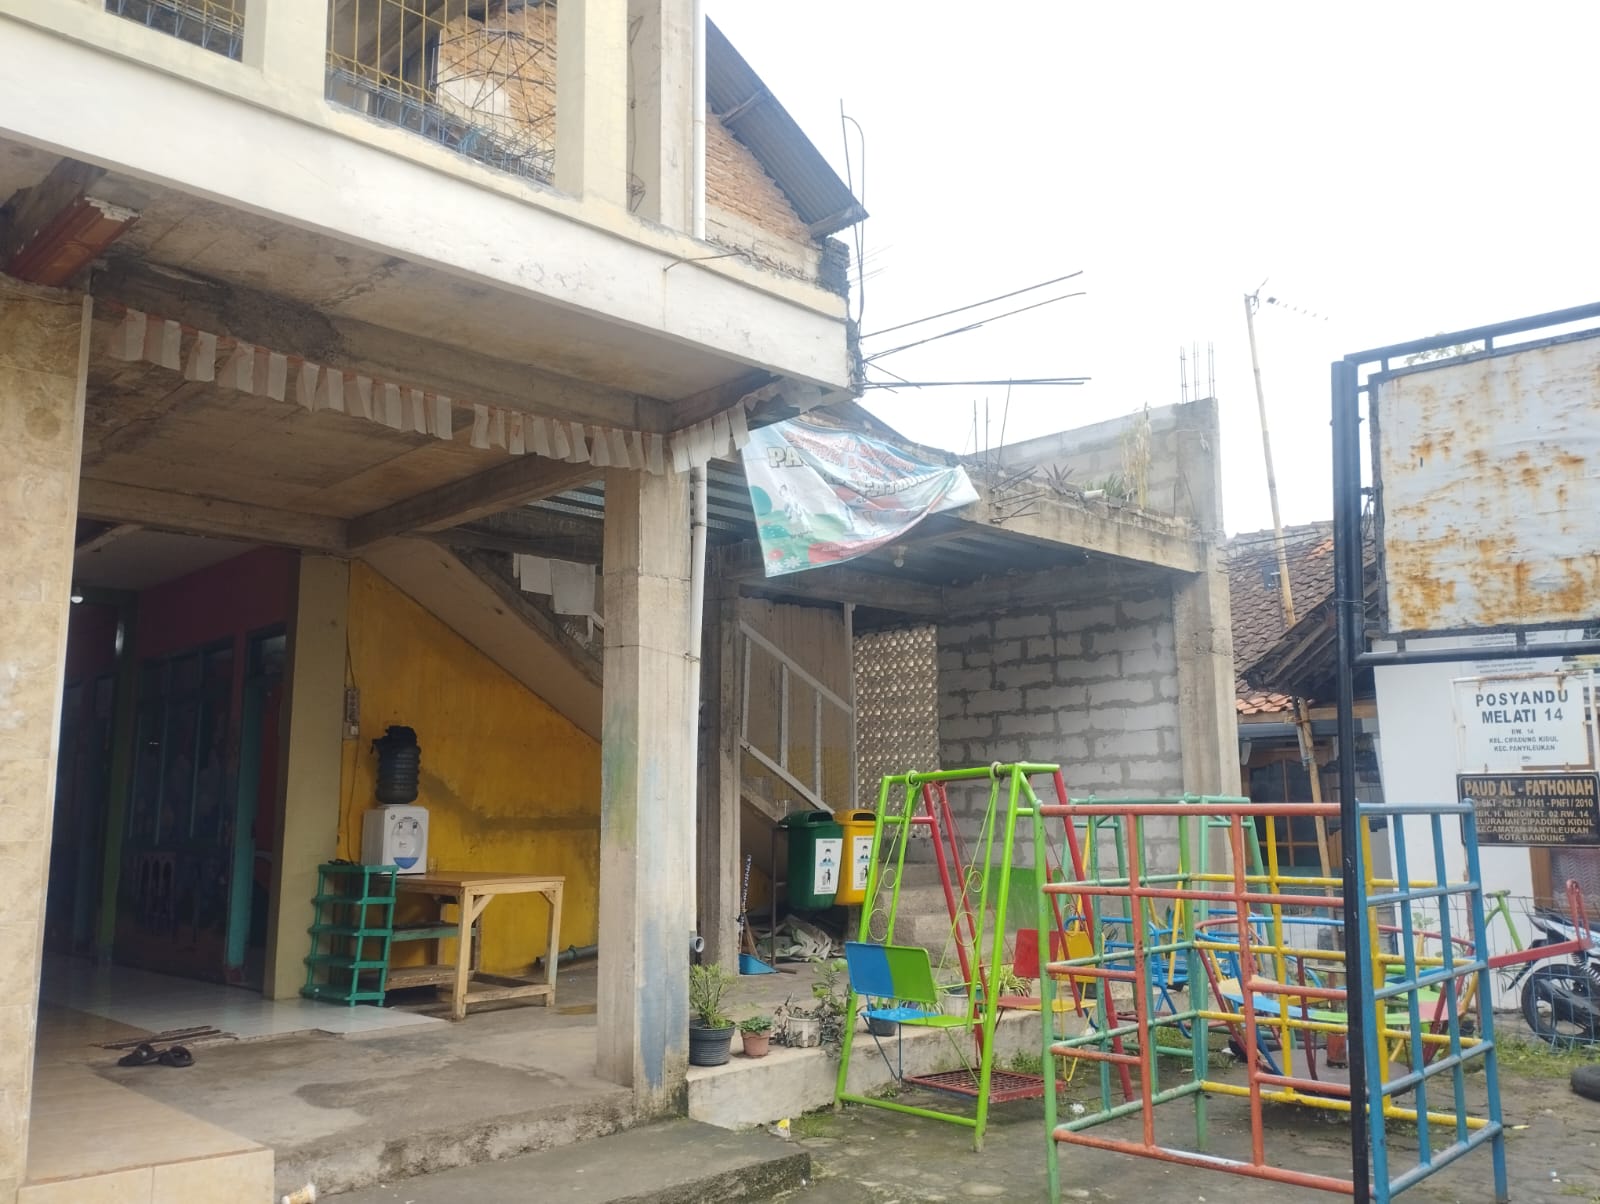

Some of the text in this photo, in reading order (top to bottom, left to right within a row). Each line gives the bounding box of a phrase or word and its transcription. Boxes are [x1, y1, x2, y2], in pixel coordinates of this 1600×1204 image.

[1475, 689, 1568, 707] POSYANDU
[1481, 707, 1564, 724] MELATI 14
[1464, 780, 1497, 796] PAUD
[1500, 780, 1516, 796] AL
[1525, 779, 1594, 796] FATHONAH
[1575, 798, 1593, 807] 2010
[1521, 818, 1566, 826] CIPADUNG
[1567, 818, 1595, 826] KIDUL
[1498, 833, 1565, 842] KOTA BANDUNG
